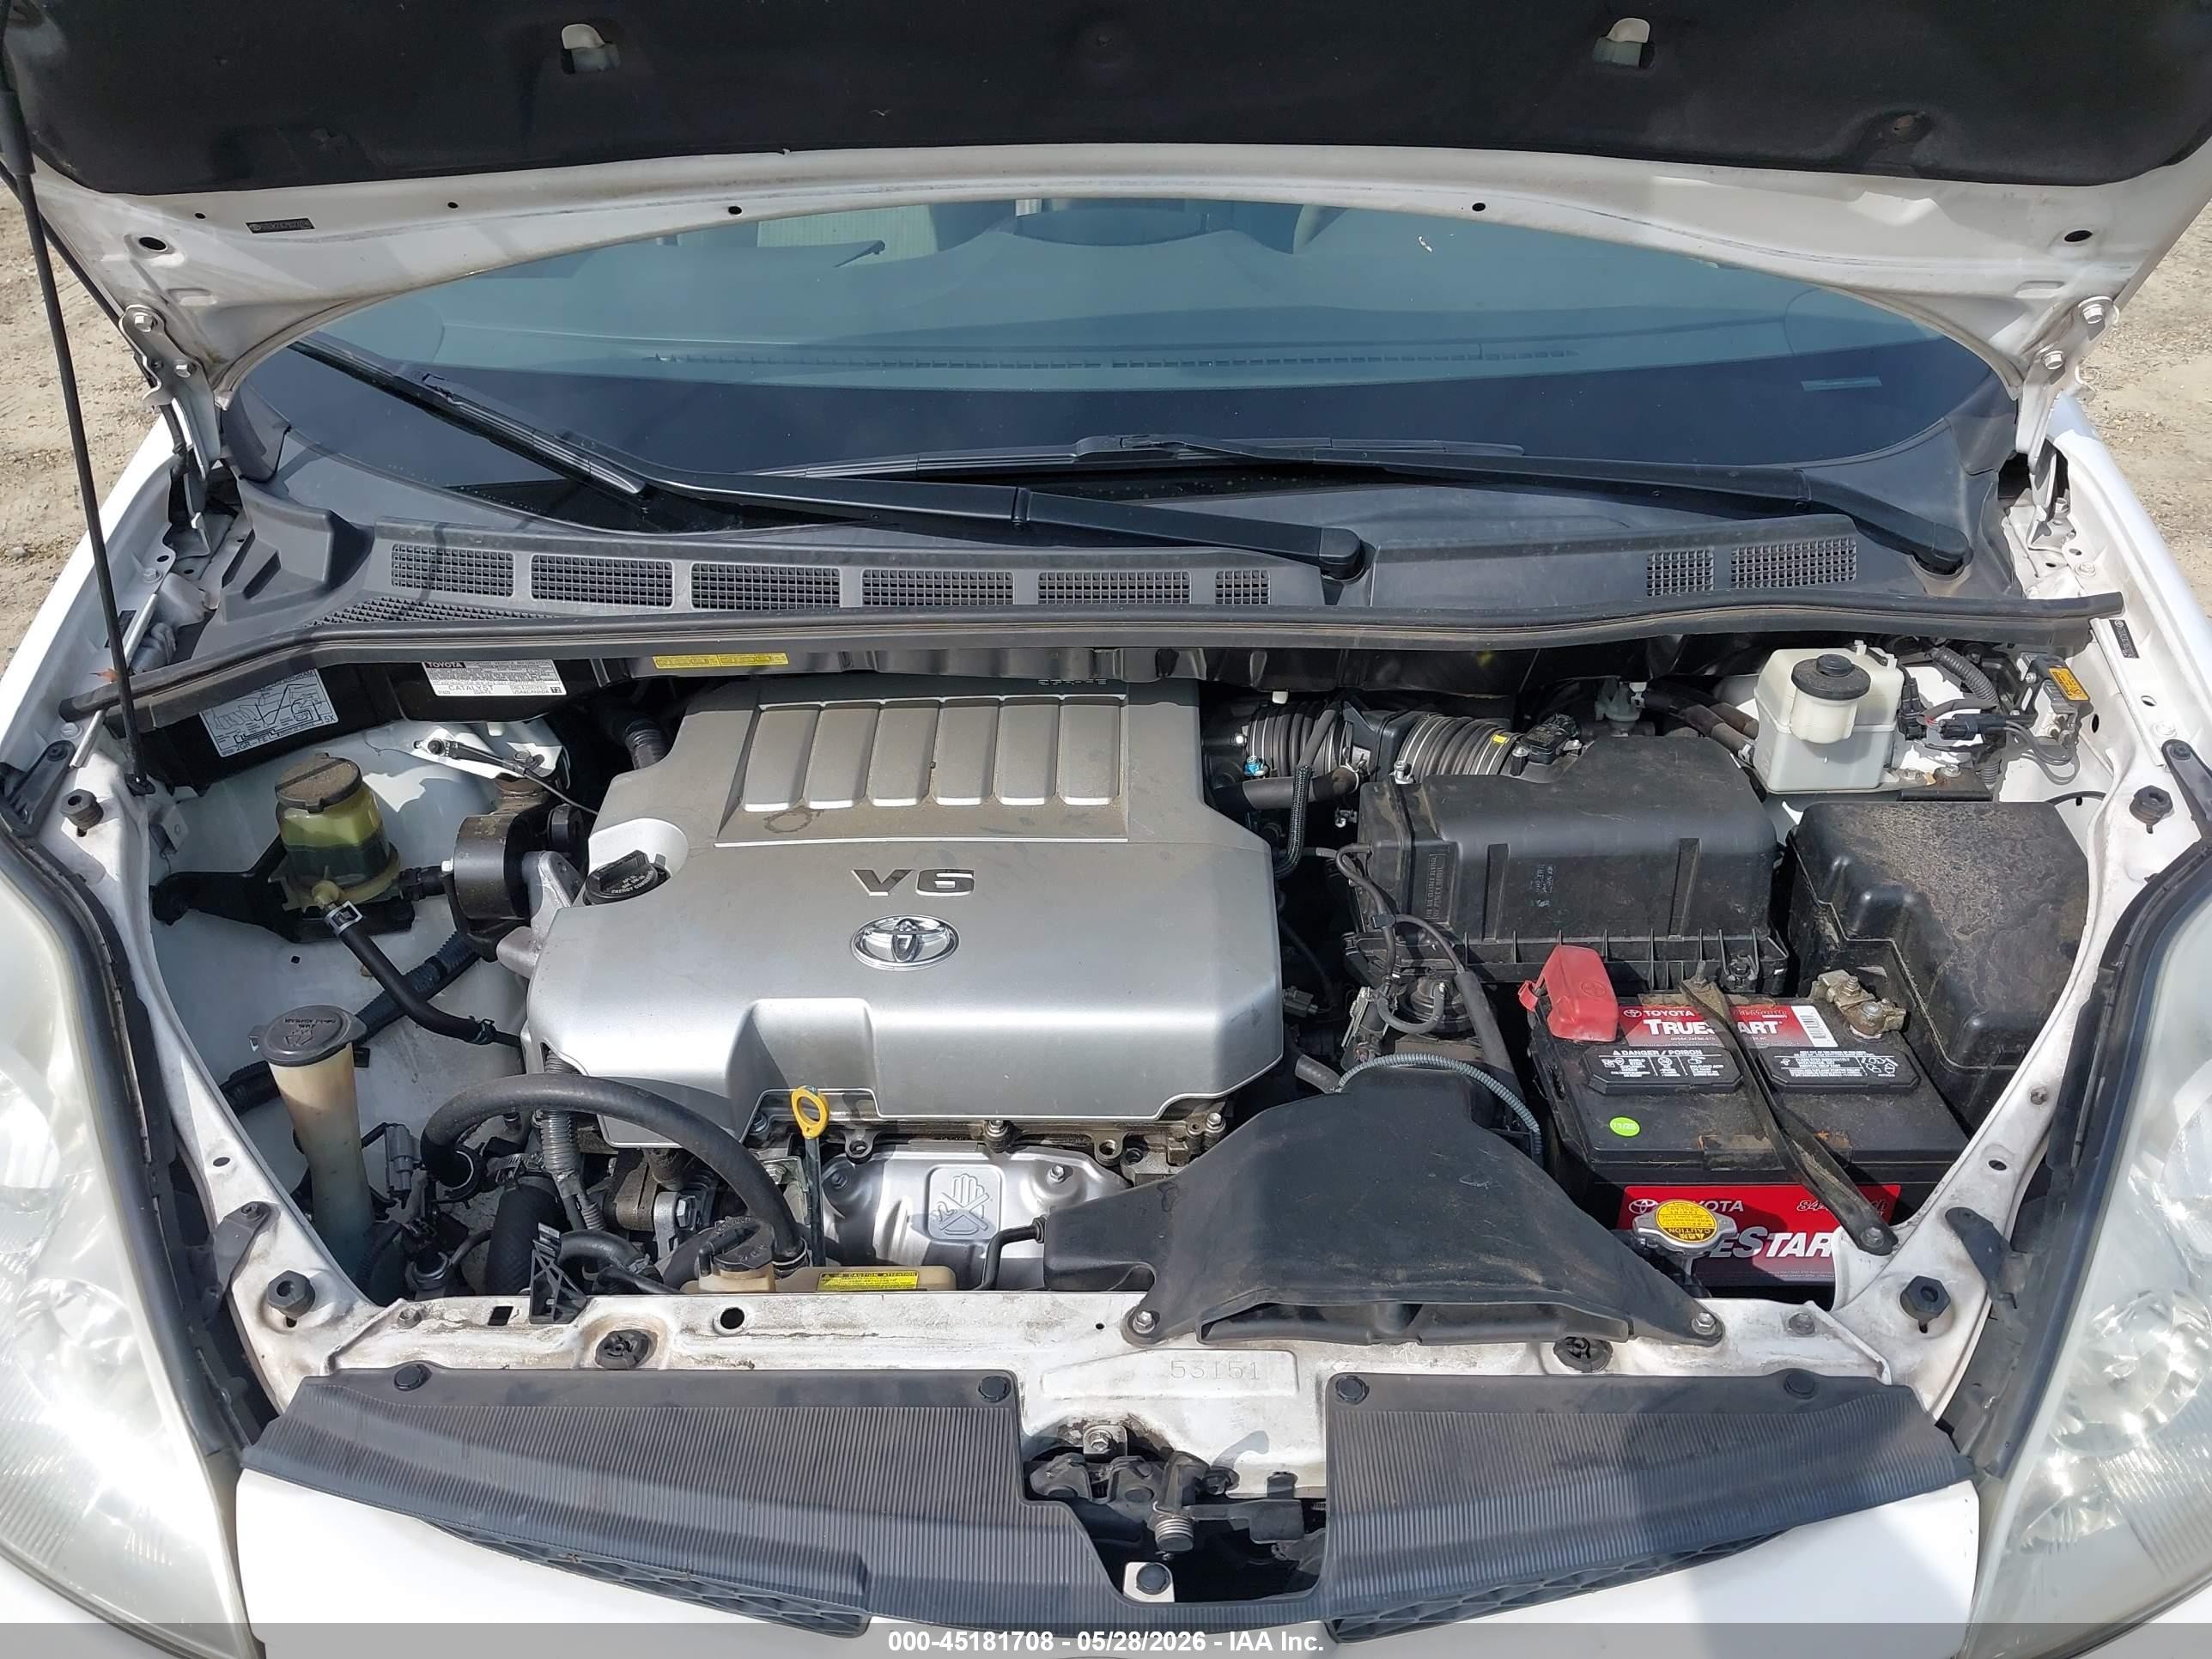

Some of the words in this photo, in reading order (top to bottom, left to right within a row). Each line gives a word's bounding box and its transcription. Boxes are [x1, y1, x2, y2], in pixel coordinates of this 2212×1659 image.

[851, 869, 975, 896] V6
[1643, 1018, 1779, 1036] TRUEART
[1170, 1360, 1261, 1380] 53151
